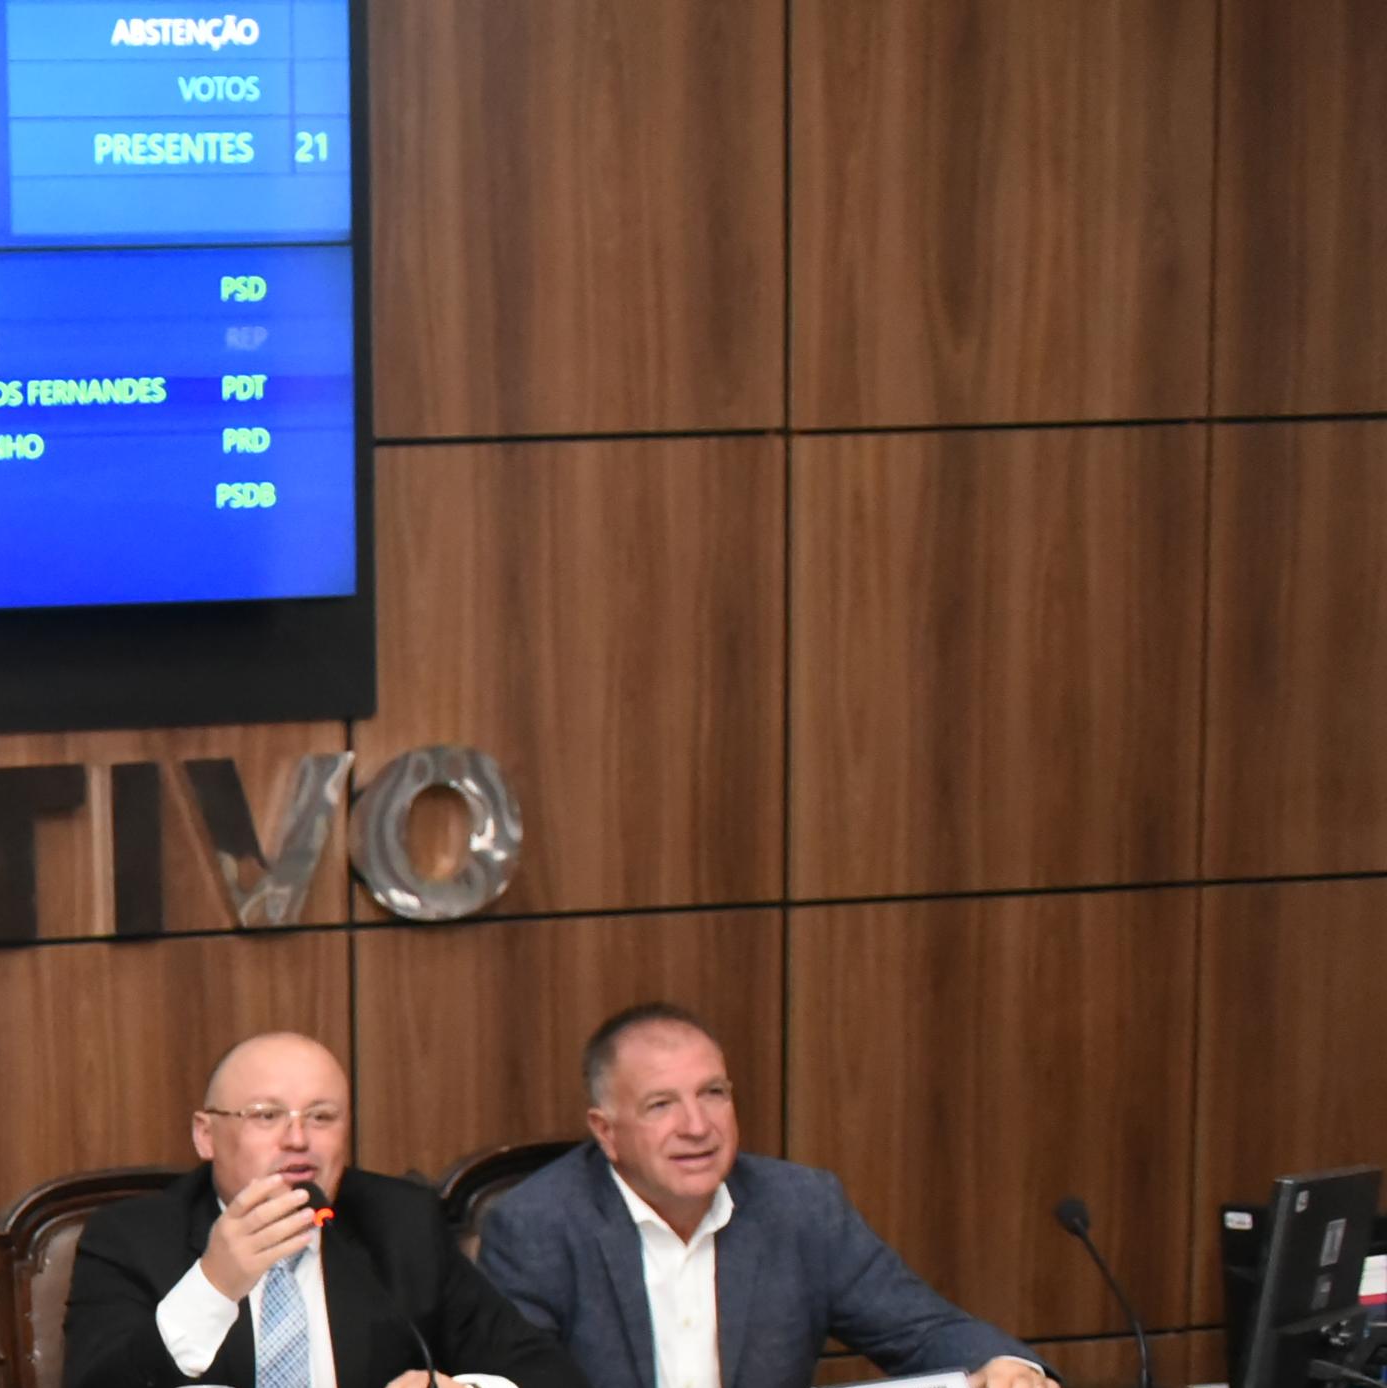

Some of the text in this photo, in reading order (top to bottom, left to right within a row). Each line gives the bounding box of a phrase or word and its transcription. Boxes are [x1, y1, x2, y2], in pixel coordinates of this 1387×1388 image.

[111, 17, 259, 50] ABSTENÇÃO
[179, 76, 260, 101] VOTOS
[94, 131, 328, 165] PRESENTES 21
[221, 277, 266, 302] PSD
[226, 326, 267, 349] REP
[27, 377, 166, 406] FERNANDES
[222, 376, 267, 401] PDT
[223, 428, 269, 453] PRD
[216, 483, 276, 509] PSDB
